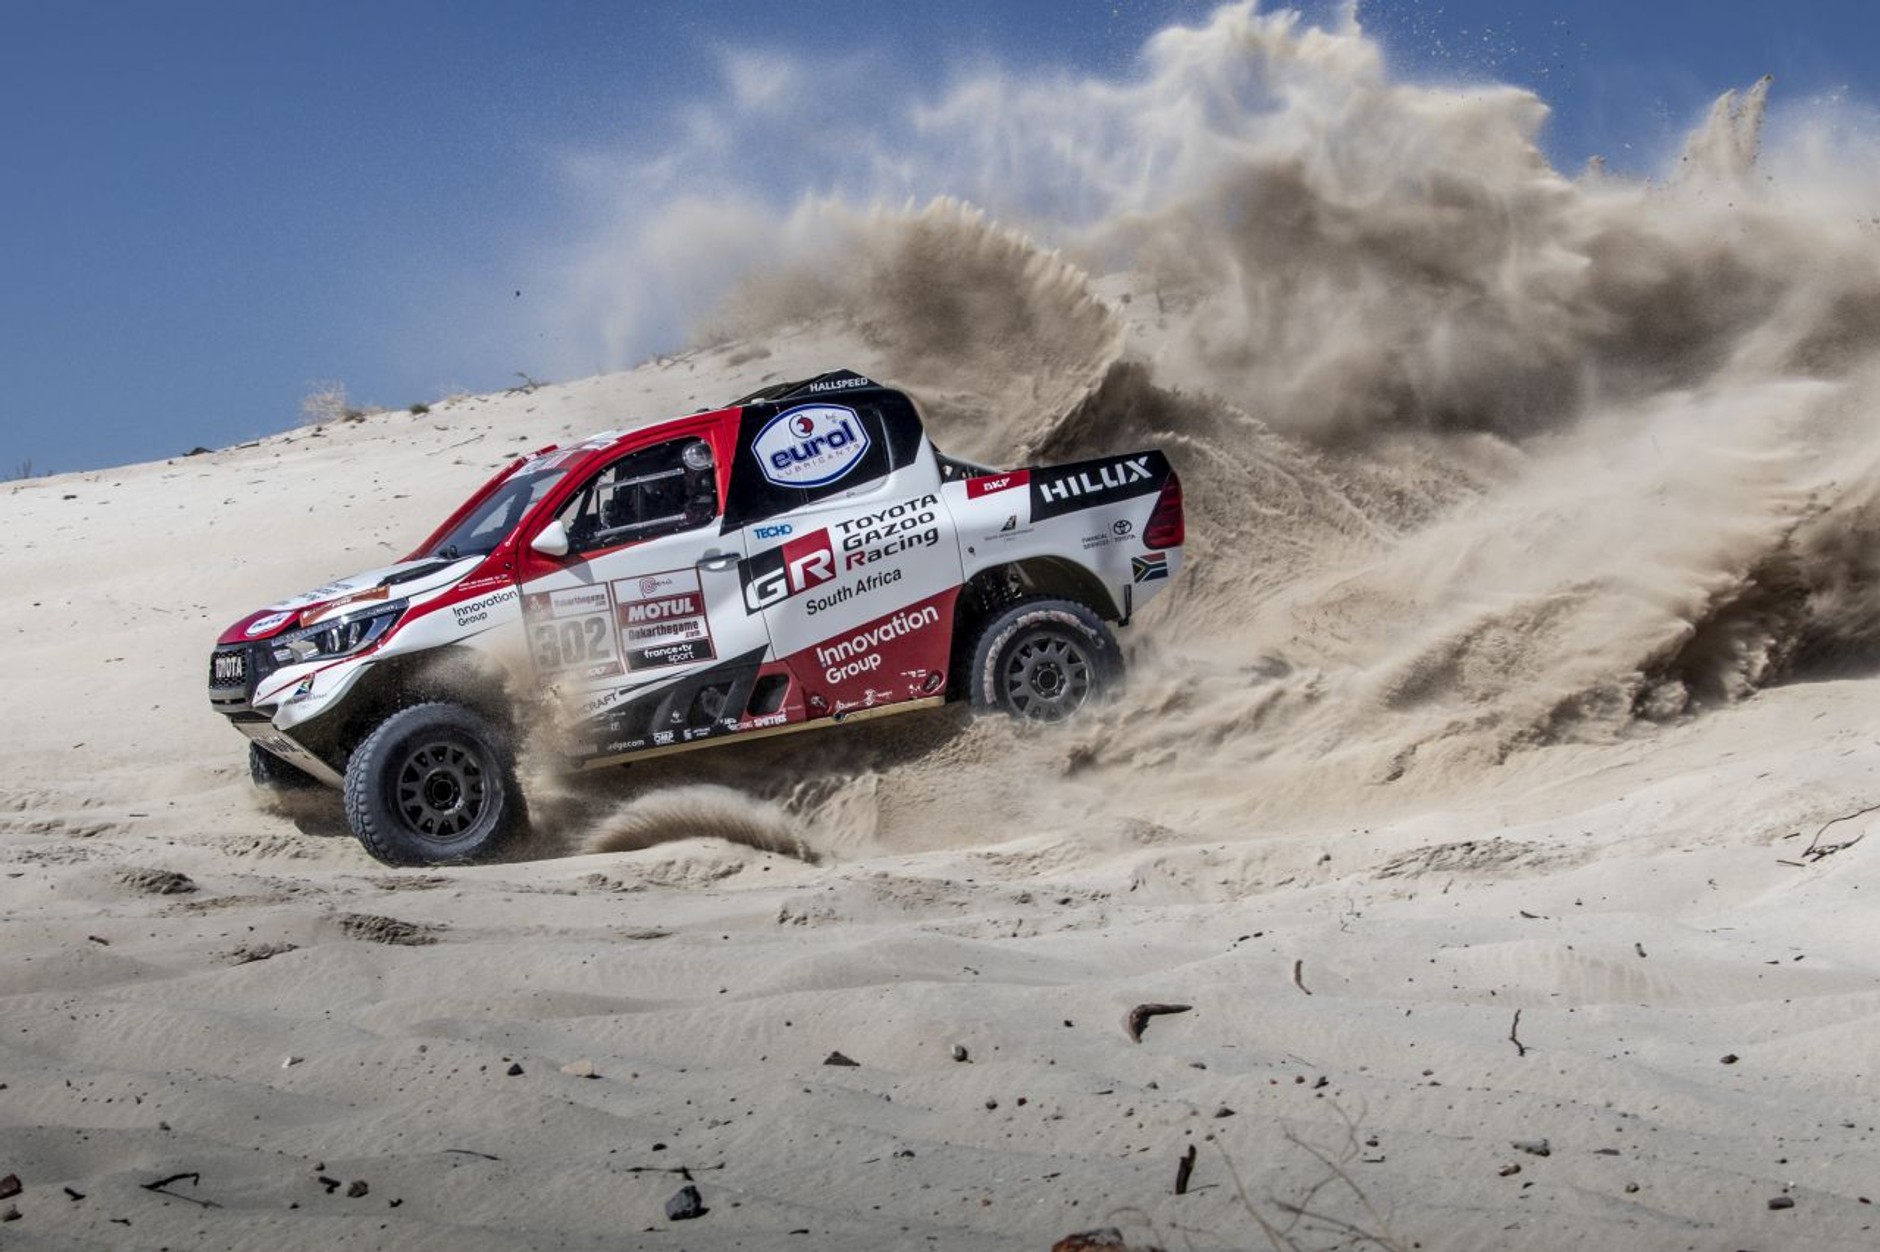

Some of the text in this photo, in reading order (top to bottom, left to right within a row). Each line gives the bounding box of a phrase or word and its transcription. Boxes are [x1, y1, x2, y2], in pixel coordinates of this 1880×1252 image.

[810, 377, 869, 393] HALLSPEED
[771, 420, 858, 471] eurol
[776, 443, 861, 479] LUBRICANTS
[1039, 456, 1152, 503] HILUX
[754, 524, 793, 540] TECHO
[835, 494, 939, 534] TOYOTA
[843, 511, 936, 552] GAZOO
[846, 527, 940, 571] Racing
[745, 548, 836, 611] GR
[806, 568, 903, 616] South Africa
[453, 589, 518, 617] Innovation
[457, 611, 488, 627] Group
[628, 597, 695, 622] MOTUL
[535, 616, 611, 668] 302
[817, 605, 939, 667] Innovation
[667, 651, 695, 664] sport
[825, 652, 882, 685] Group
